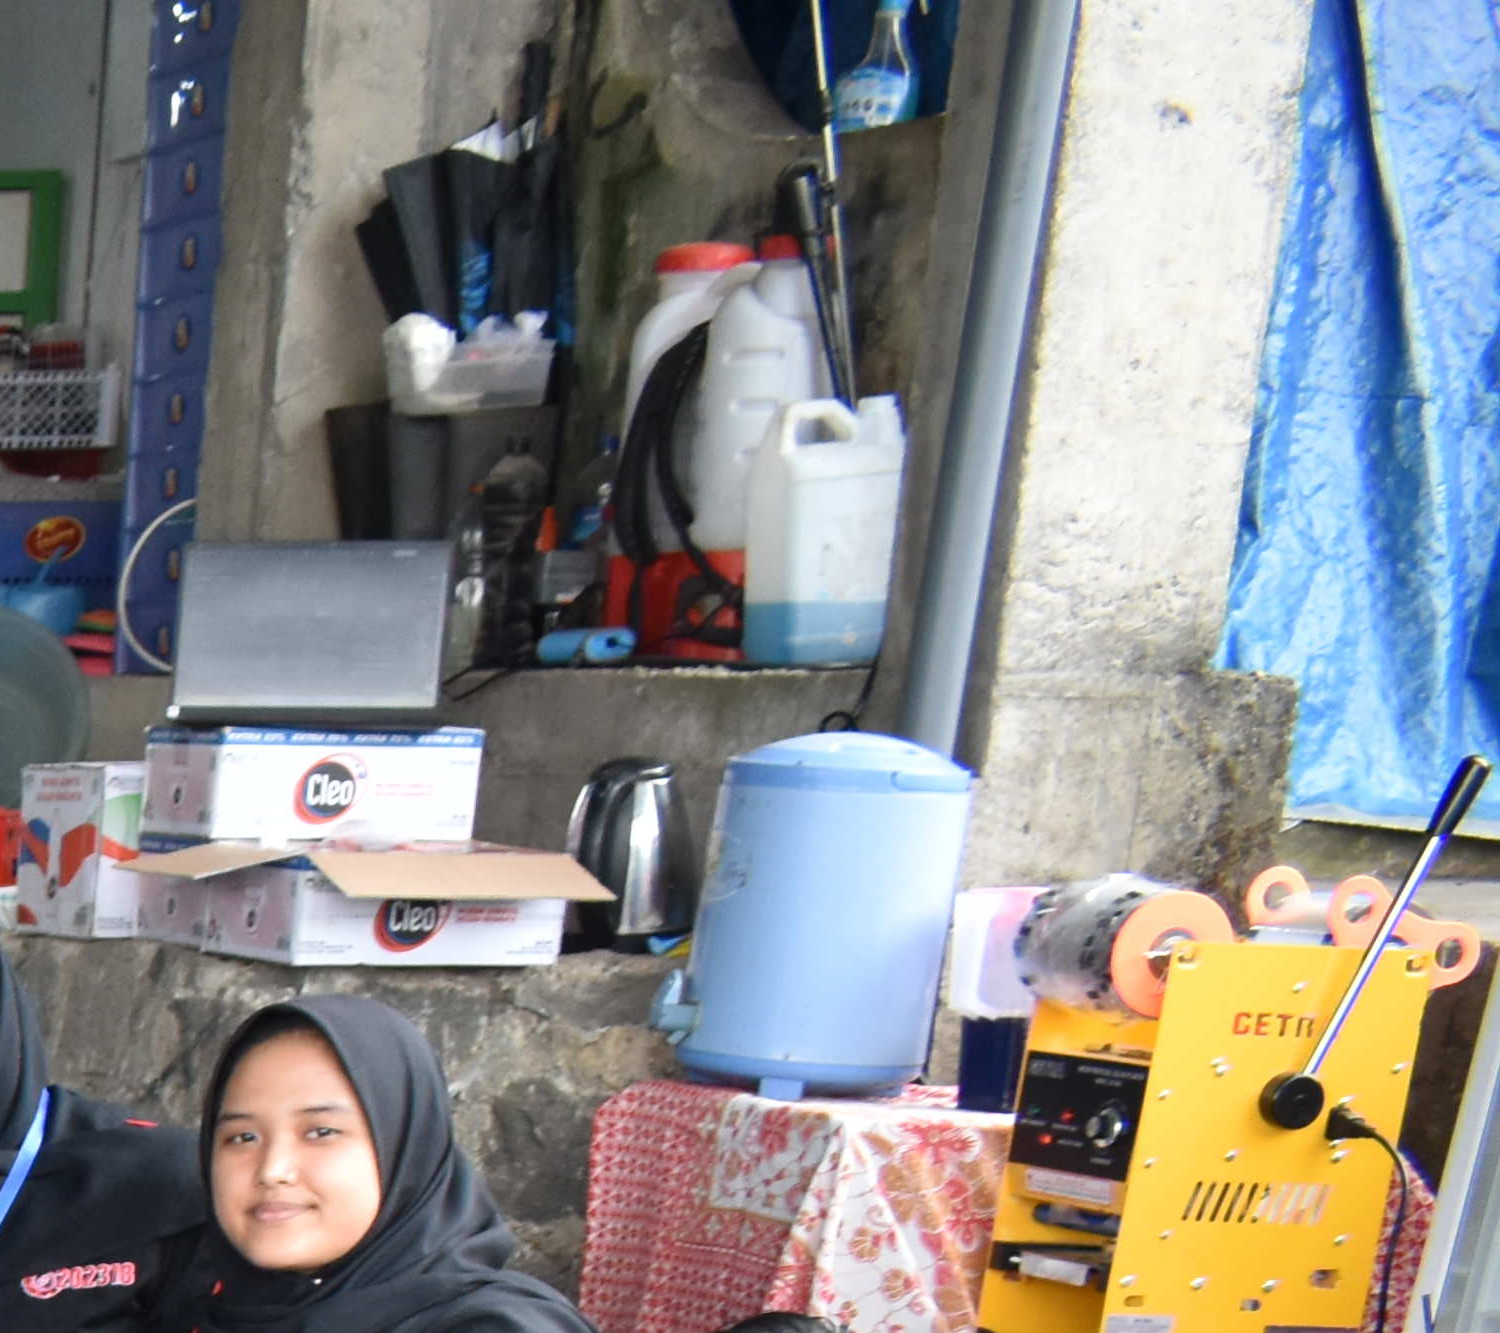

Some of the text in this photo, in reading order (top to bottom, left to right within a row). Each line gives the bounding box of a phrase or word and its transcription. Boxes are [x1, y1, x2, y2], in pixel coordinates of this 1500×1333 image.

[306, 773, 353, 807] Cleo
[387, 898, 437, 933] Cleo
[57, 1261, 136, 1290] 202318
